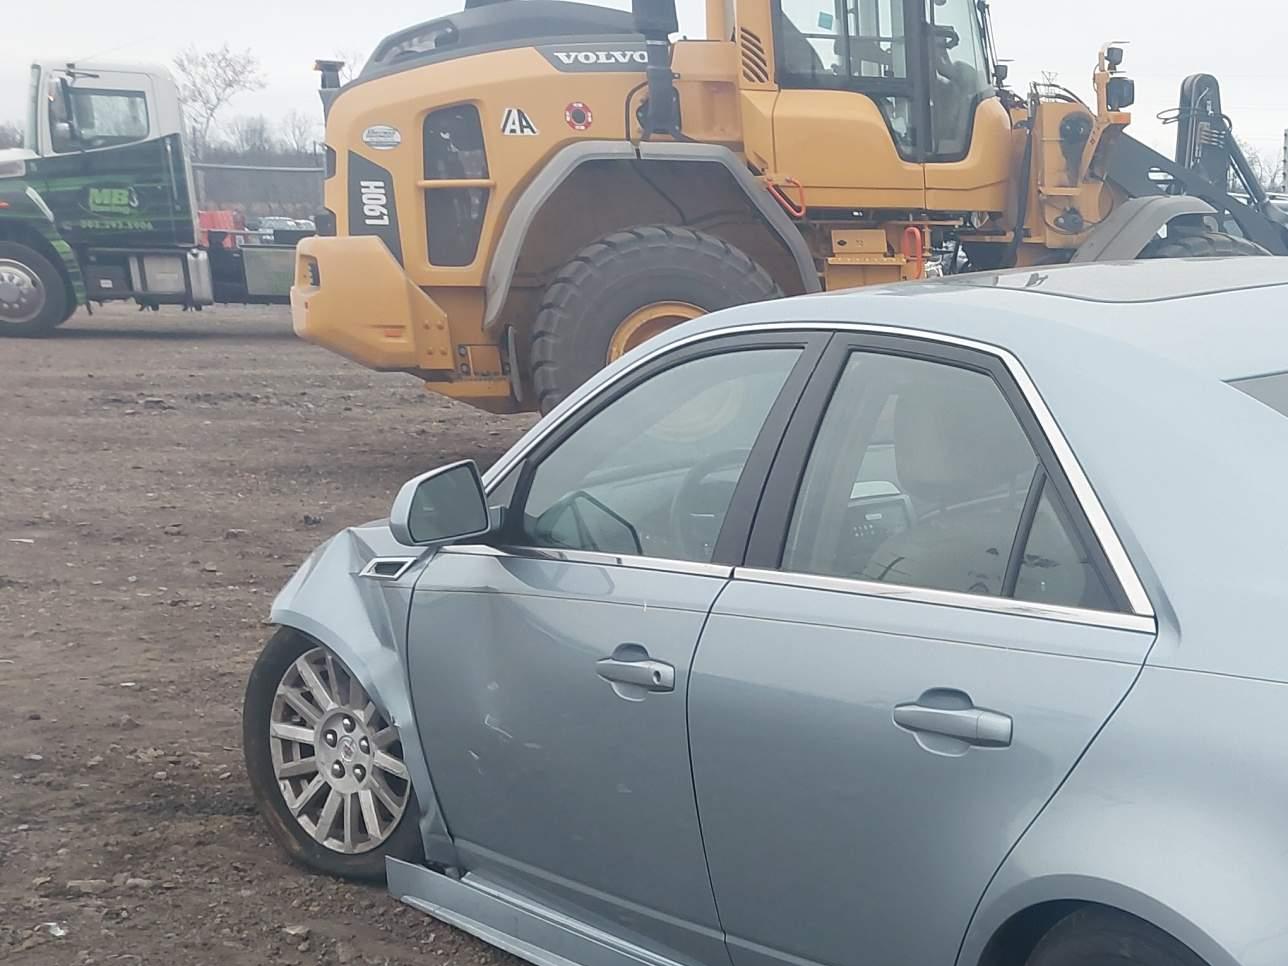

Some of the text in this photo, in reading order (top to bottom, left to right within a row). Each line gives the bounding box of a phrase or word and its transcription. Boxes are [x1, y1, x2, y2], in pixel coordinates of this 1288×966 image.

[554, 51, 648, 64] VOLVO
[89, 188, 129, 206] MB
[360, 181, 389, 225] L90H
